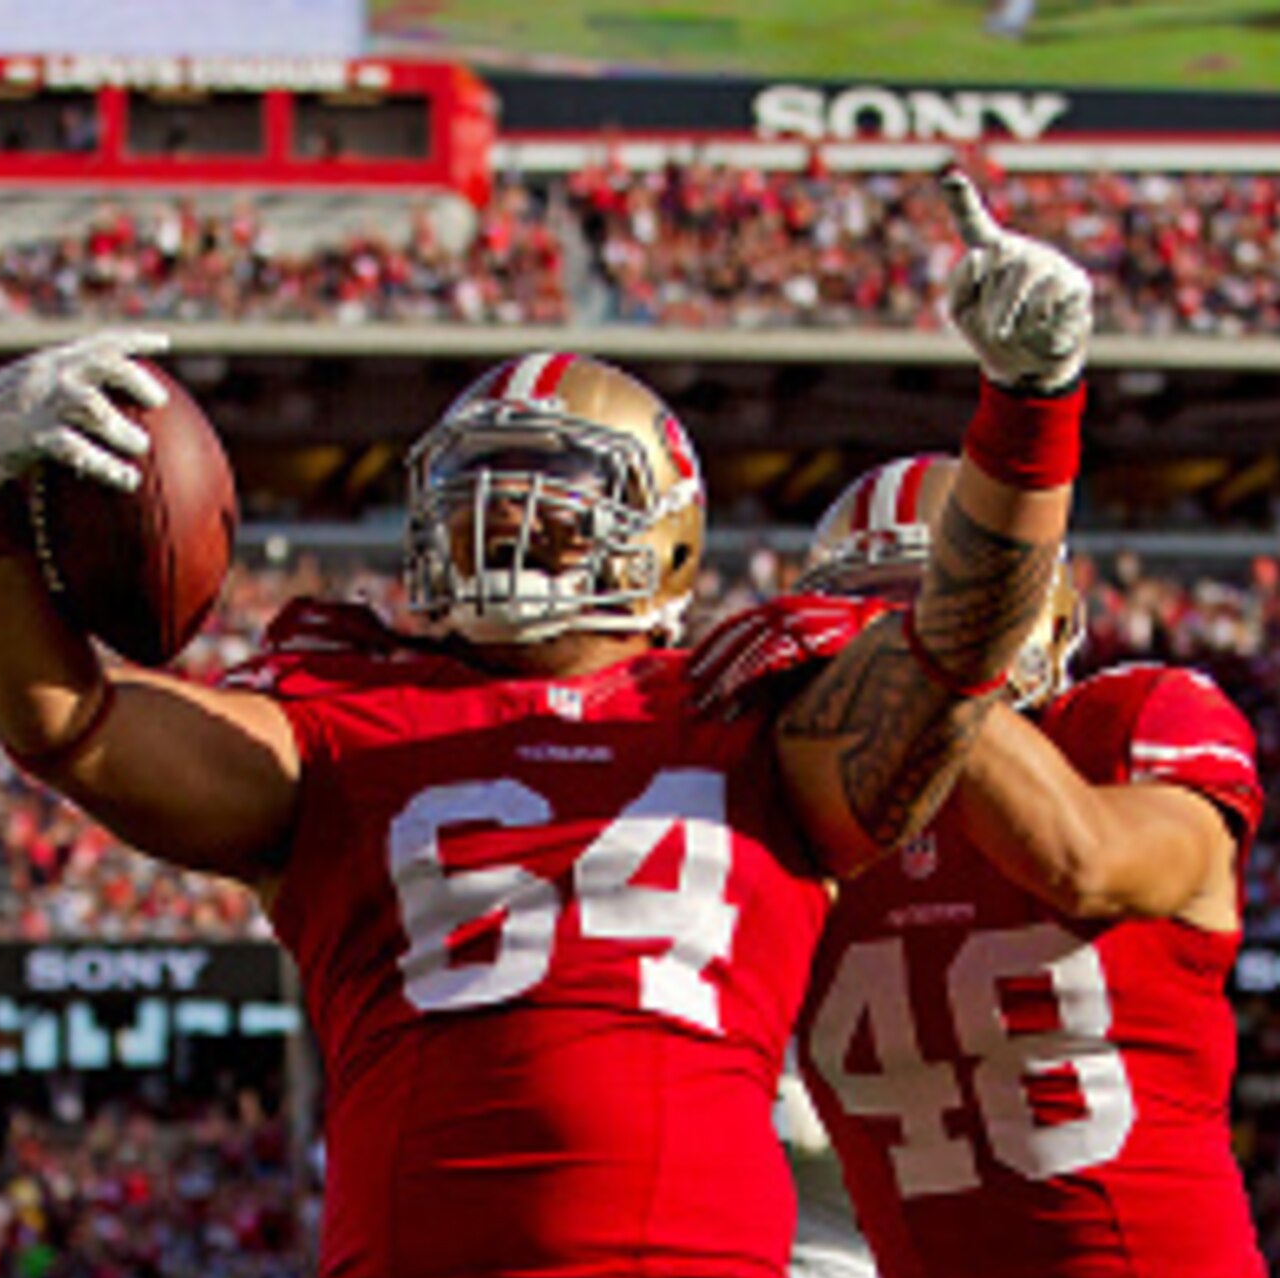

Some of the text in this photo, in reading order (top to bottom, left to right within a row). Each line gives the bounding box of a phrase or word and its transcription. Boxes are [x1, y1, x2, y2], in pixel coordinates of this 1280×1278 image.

[753, 84, 1065, 139] SONY
[26, 951, 208, 990] SONY
[389, 769, 738, 1036] 64
[811, 923, 1136, 1198] 48
